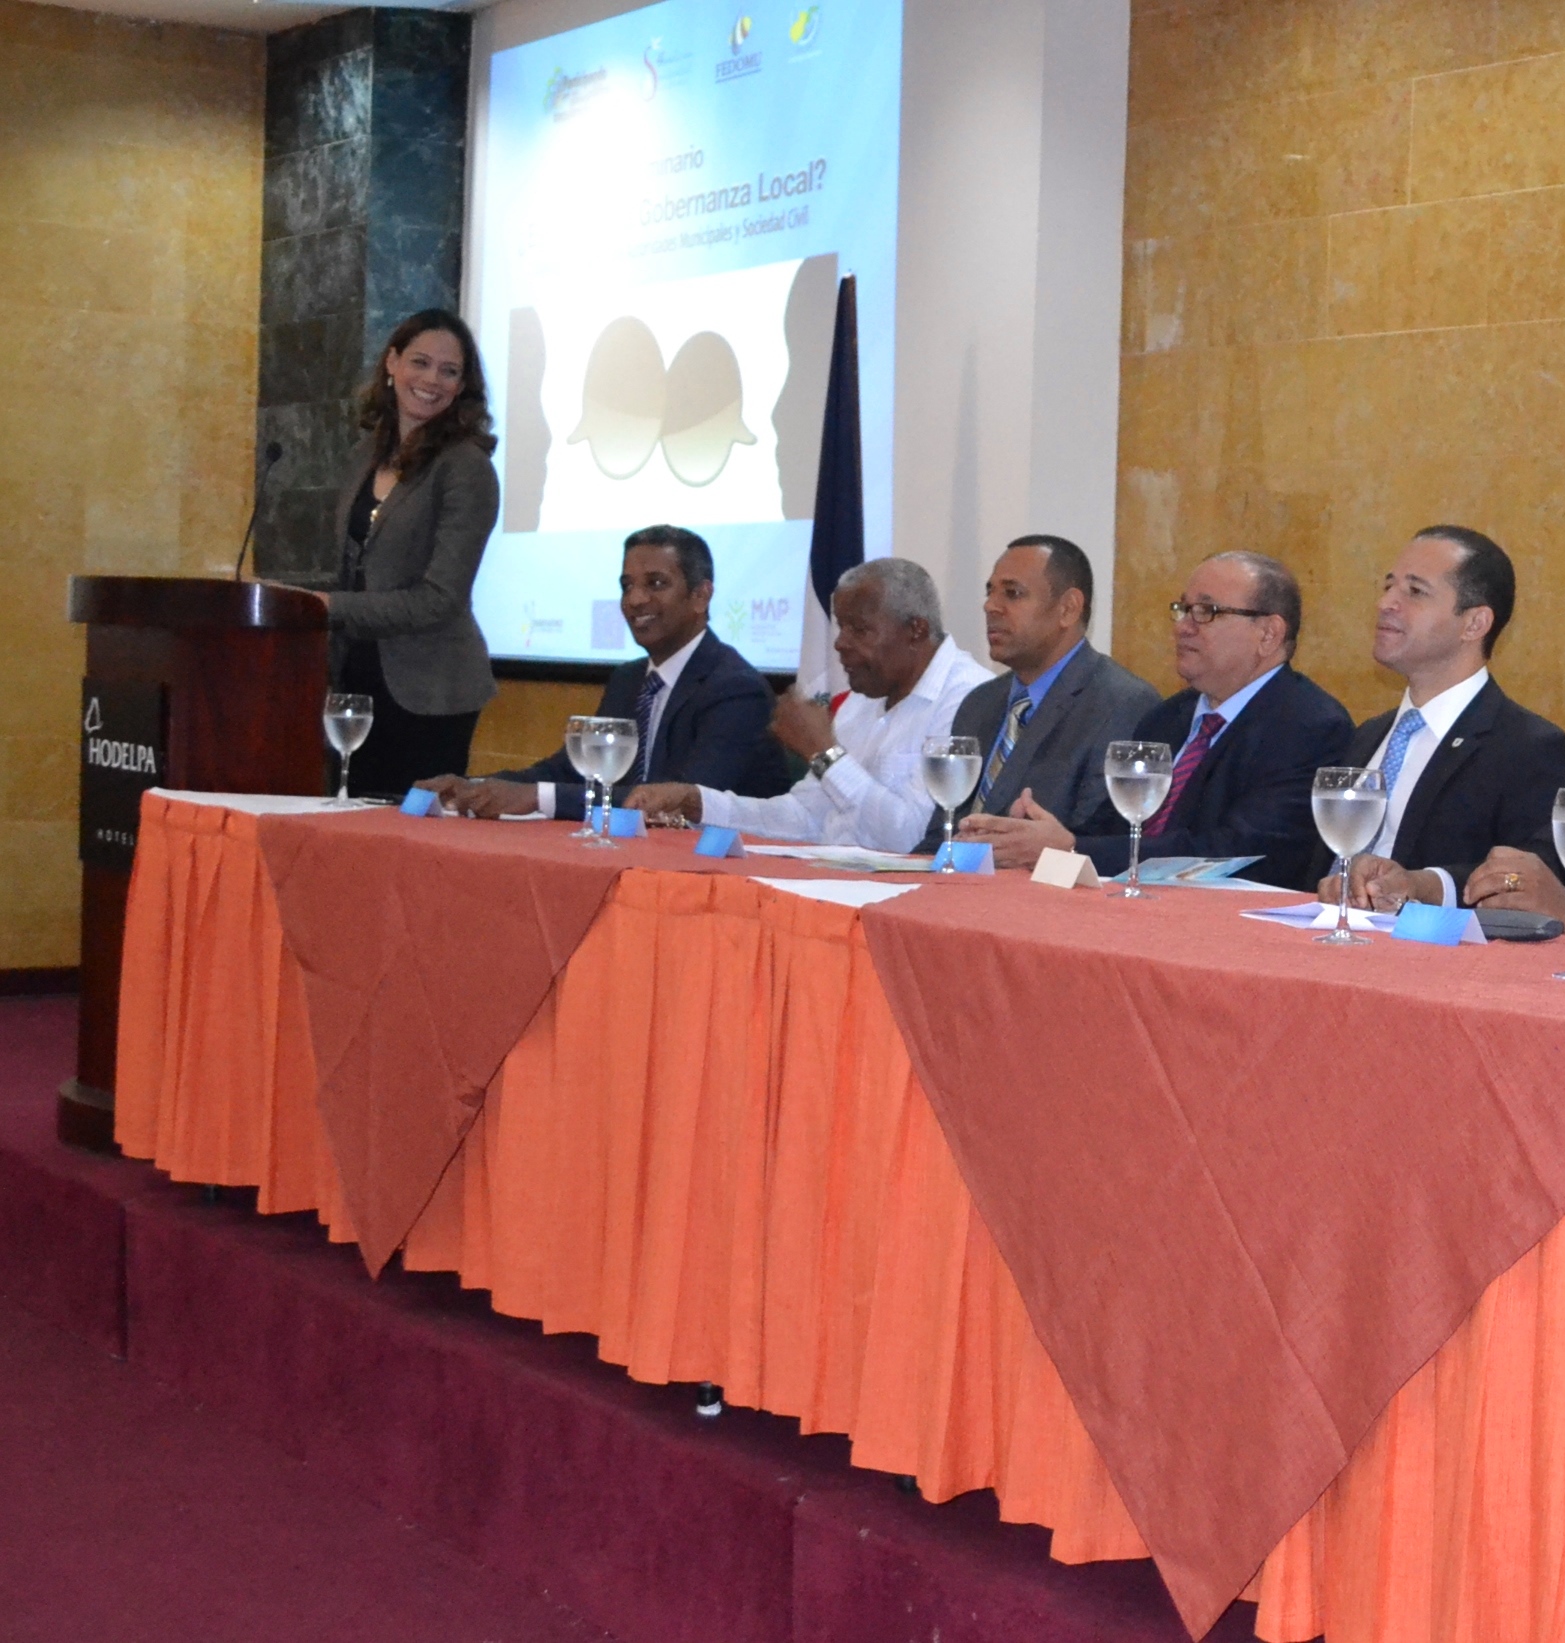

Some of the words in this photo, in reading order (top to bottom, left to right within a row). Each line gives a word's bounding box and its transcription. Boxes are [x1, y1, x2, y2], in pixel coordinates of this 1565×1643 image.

[640, 182, 751, 226] Gobernanza
[758, 157, 827, 203] Local?
[751, 597, 789, 622] MAP
[88, 737, 157, 774] HODELPA
